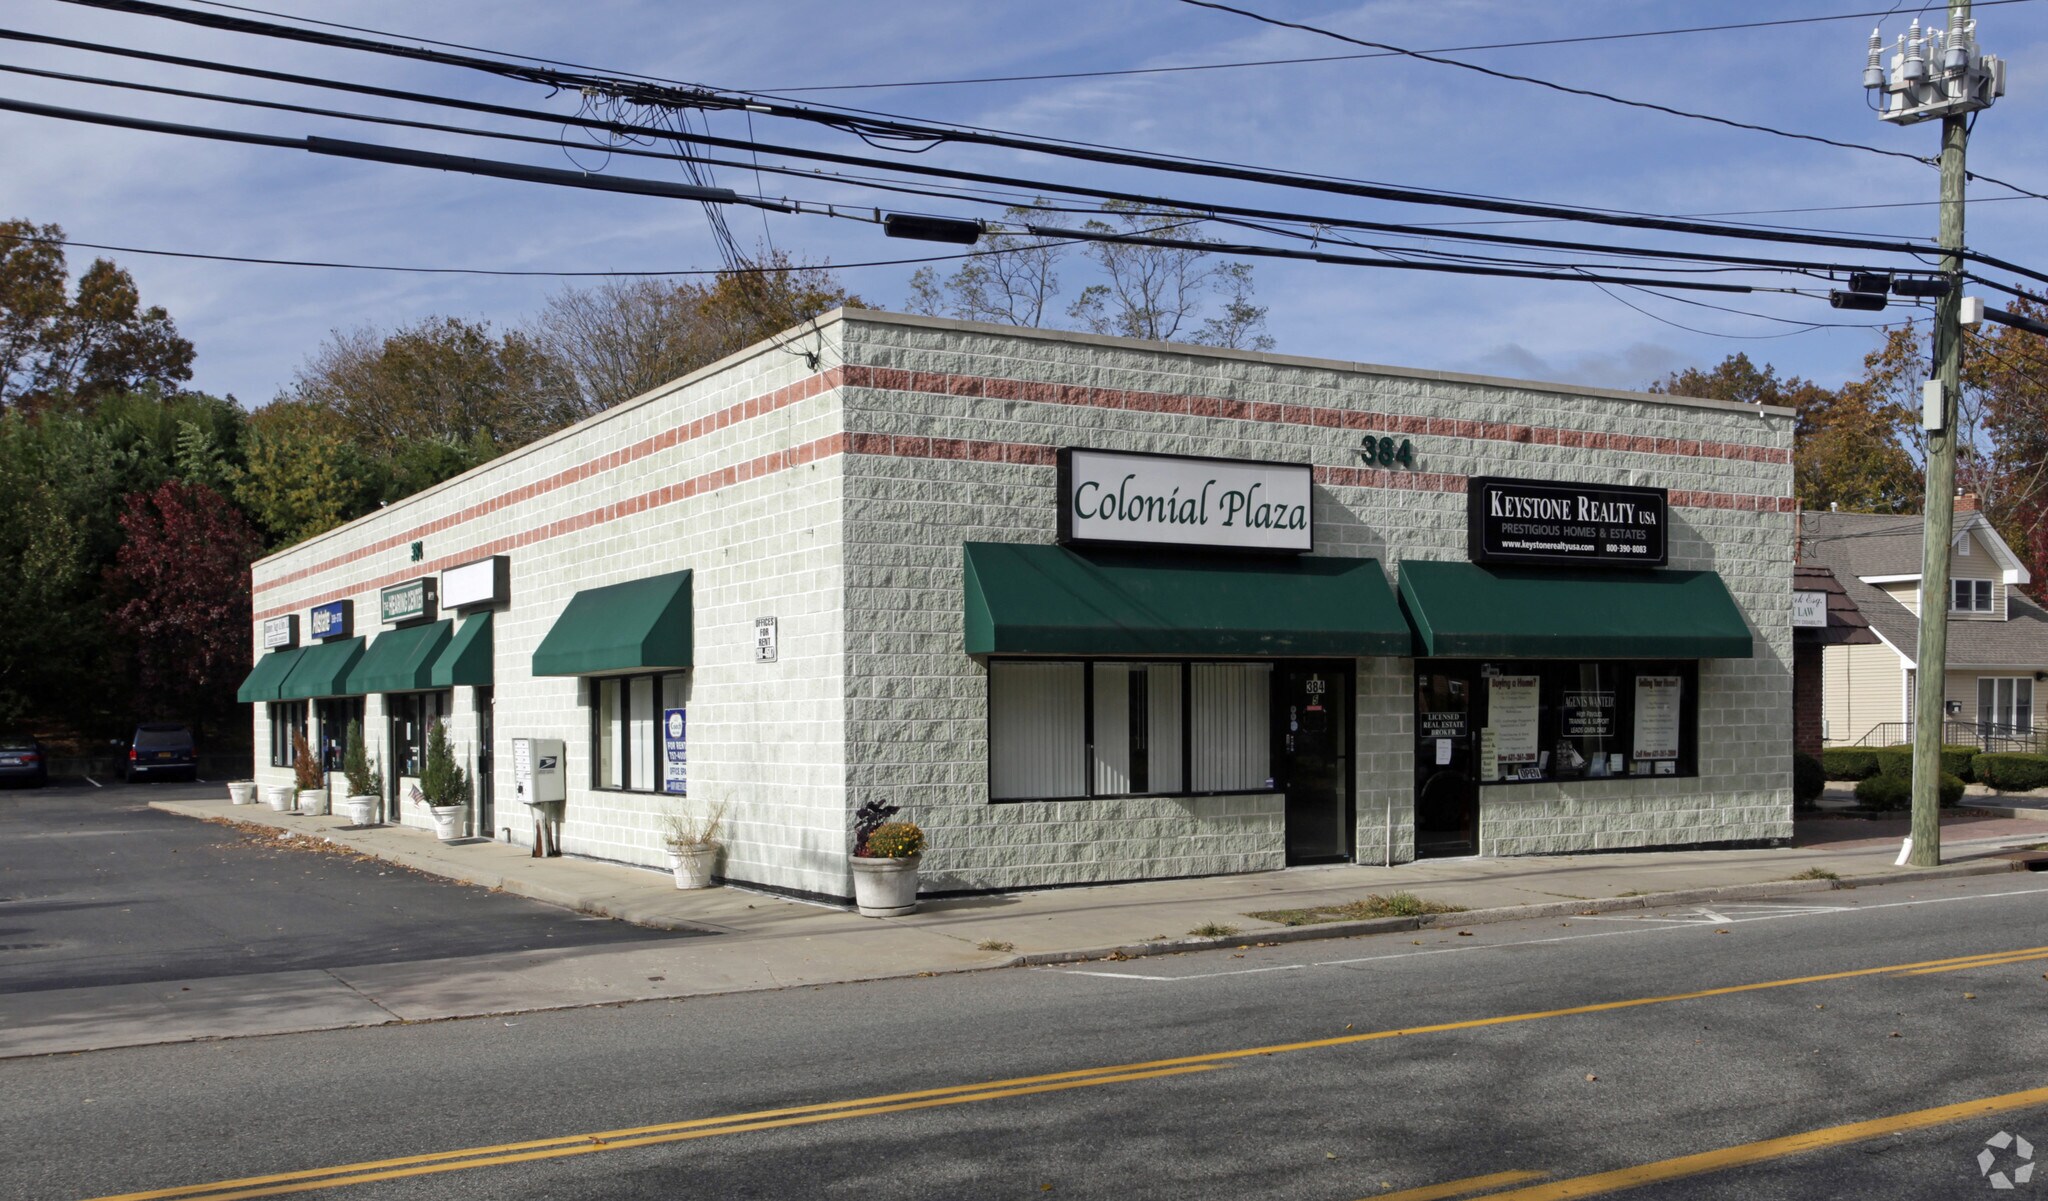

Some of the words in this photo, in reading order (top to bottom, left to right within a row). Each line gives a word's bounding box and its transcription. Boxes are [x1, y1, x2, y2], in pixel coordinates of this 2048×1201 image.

[1361, 435, 1413, 468] 384
[1074, 474, 1216, 525] Colonial
[1219, 482, 1307, 530] Plaza
[1490, 490, 1571, 521] KEYSTONE
[1577, 496, 1635, 524] REALTY
[1639, 511, 1656, 525] USA
[1502, 522, 1560, 536] PRESTIGIOUS
[1563, 526, 1596, 538] HOMES
[1600, 527, 1606, 538] &
[1610, 528, 1646, 540] ESTATES
[1502, 539, 1594, 552] www.keystonerealtyusa.com
[1606, 543, 1647, 554] 800-390-8083
[1805, 593, 1823, 608] Esq.
[1798, 607, 1814, 617] LAW
[755, 617, 774, 628] OFFICES
[759, 628, 769, 637] FOR
[758, 637, 771, 647] RENT
[1307, 681, 1325, 693] 384
[1492, 678, 1511, 689] Buying
[1517, 678, 1536, 688] Home?
[1565, 695, 1588, 708] AGENTS
[1431, 728, 1457, 736] BROKER
[667, 741, 675, 750] FOR
[1520, 768, 1540, 779] OPEN
